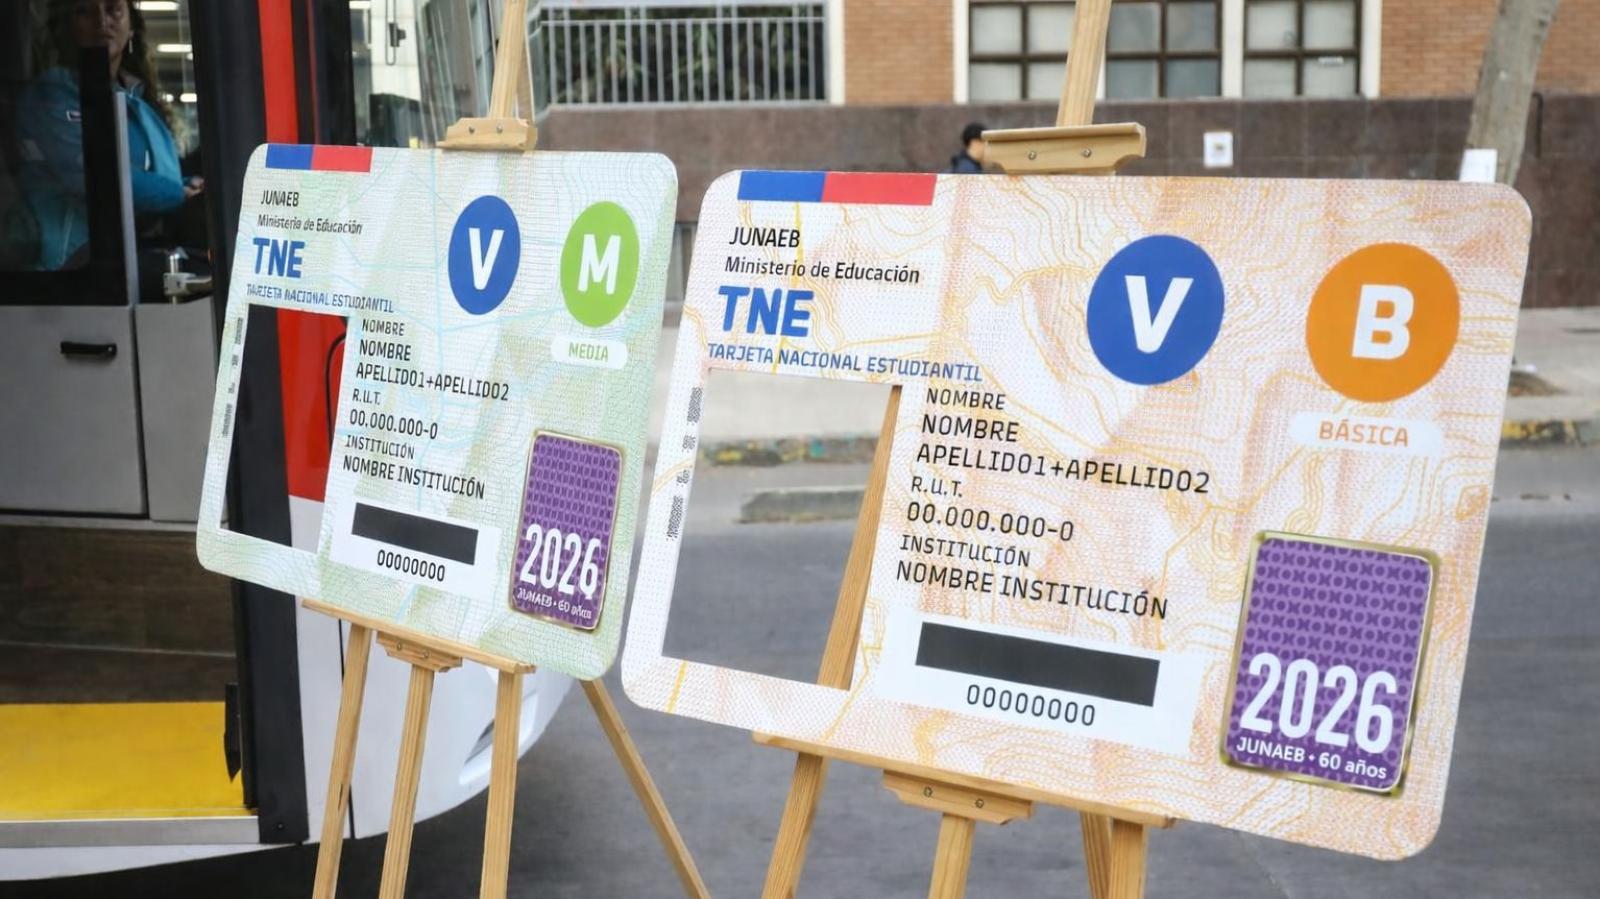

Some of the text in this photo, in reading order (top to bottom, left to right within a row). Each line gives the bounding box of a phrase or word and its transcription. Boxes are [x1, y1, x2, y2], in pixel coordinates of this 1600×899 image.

[261, 190, 299, 207] JUNAEB
[257, 214, 362, 235] Ministerio de Educación
[729, 227, 800, 248] JUNAEB
[253, 237, 305, 278] TNE
[468, 227, 505, 290] V
[577, 234, 621, 294] M
[724, 256, 920, 284] Ministerio de Educación
[284, 289, 330, 306] NACIONAL
[332, 293, 394, 313] ESTUDIANTIL
[718, 285, 814, 338] TNE
[1124, 275, 1194, 353] V
[362, 319, 405, 336] NOMBRE
[1352, 284, 1415, 361] B
[359, 339, 411, 361] NOMBRE
[568, 342, 609, 361] MEDIA
[707, 343, 983, 382] TARJETA NACIONAL ESTUDIANTIL
[352, 388, 381, 405] R.U.T.
[355, 362, 509, 401] APELLIDO1+APELLIDO2
[926, 388, 1006, 410] NOMBRE
[350, 409, 438, 440] 00.000.000-0
[921, 413, 1019, 442] NOMBRE
[1319, 418, 1409, 447] BÁSICA
[345, 434, 415, 460] INSTITUCIÓN
[343, 455, 485, 499] NOMBRE INSTITUCIÓN
[916, 443, 1210, 494] APELLIDO1+APELLIDO2
[911, 475, 963, 498] R.U.T.
[907, 502, 1074, 541] 00.000.000-0
[377, 549, 446, 582] 00000000
[520, 523, 601, 600] 2026
[899, 534, 1031, 567] INSTITUCIÓN
[896, 560, 1168, 620] NOMBRE INSTITUCIÓN
[967, 684, 1096, 726] 00000000
[1239, 652, 1397, 754] 2026
[1236, 736, 1387, 779] JUNAEB 60 años
